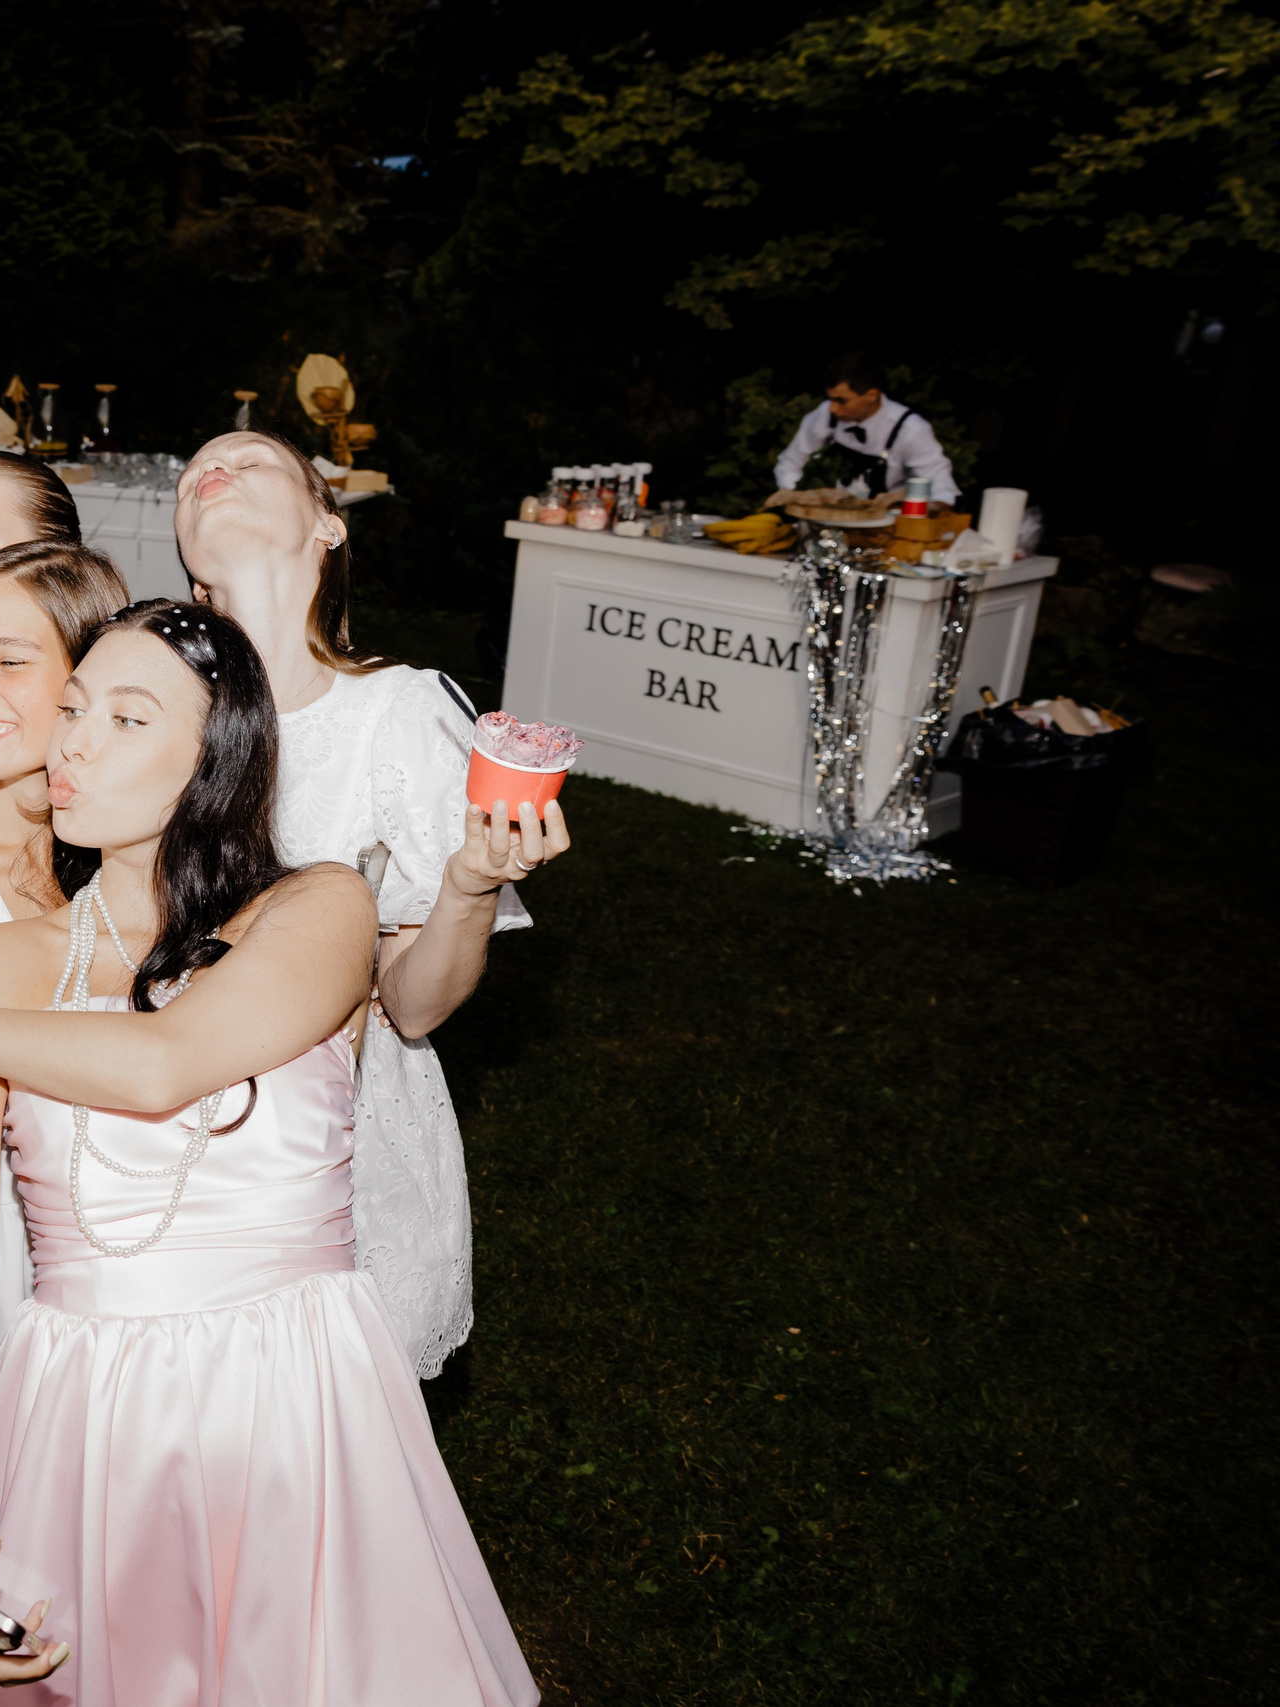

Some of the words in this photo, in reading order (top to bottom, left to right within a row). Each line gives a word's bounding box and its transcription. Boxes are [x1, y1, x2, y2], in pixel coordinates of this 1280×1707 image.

[585, 603, 646, 641] ICE
[657, 617, 802, 672] CREAM
[643, 668, 722, 713] BAR
